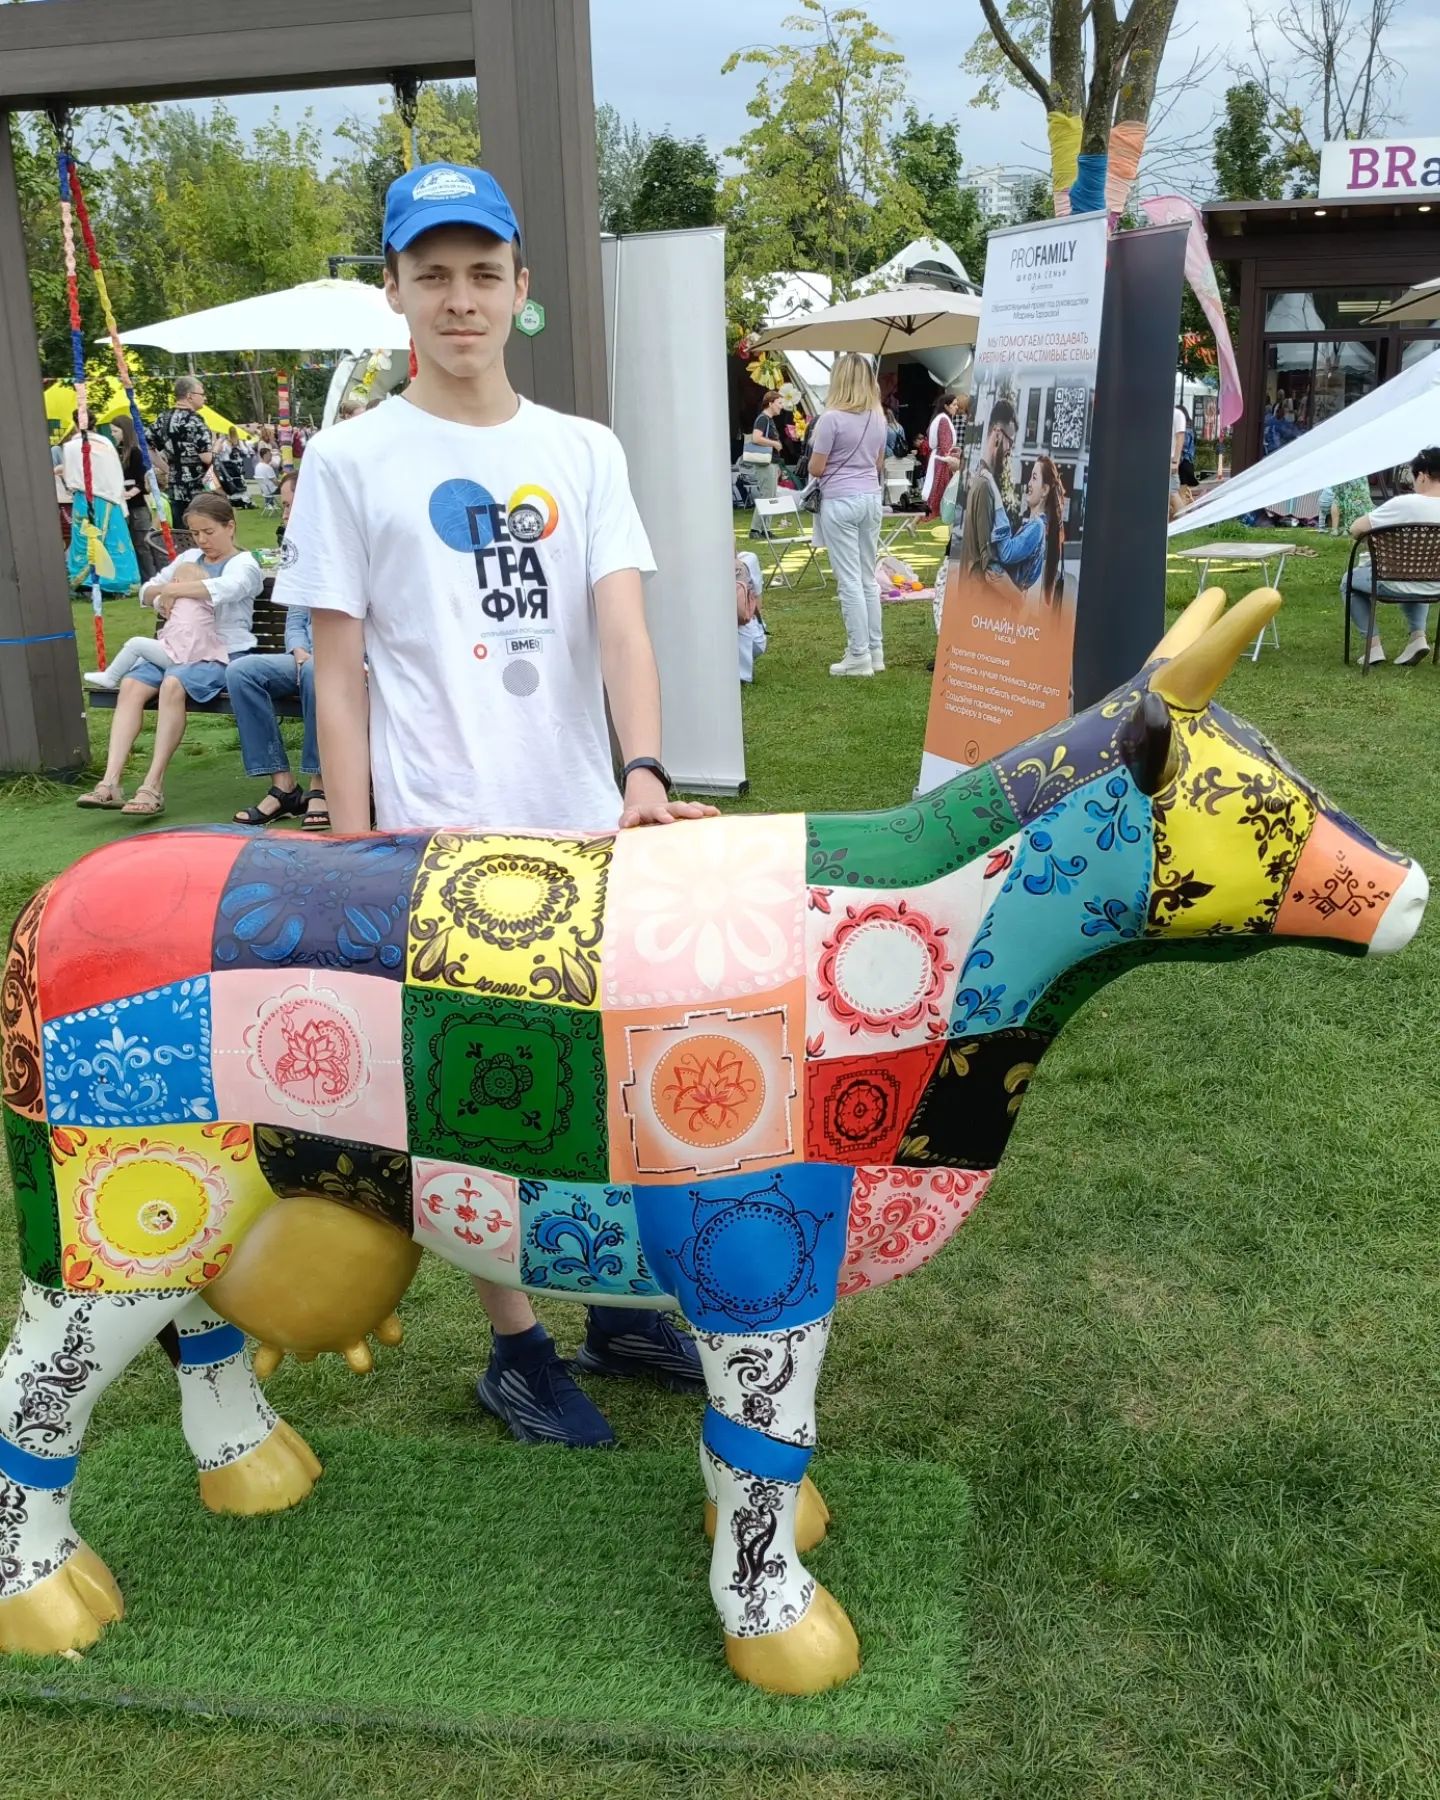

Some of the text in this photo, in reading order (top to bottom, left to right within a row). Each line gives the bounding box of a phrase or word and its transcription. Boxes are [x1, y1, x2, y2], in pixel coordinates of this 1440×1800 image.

[1010, 240, 1077, 270] PROFAMILY
[1016, 273, 1041, 282] ШКОЛА
[999, 334, 1044, 347] ПОМОГАЕМ
[1045, 331, 1088, 346] СОЗДАВАТЬ
[1009, 351, 1015, 362] И
[1017, 348, 1068, 362] СЧАСТЛИВЫЕ
[1070, 347, 1096, 361] СЕМЬИ
[474, 546, 548, 589] ГРА
[971, 614, 1040, 641] ОНЛАЙН КУРС
